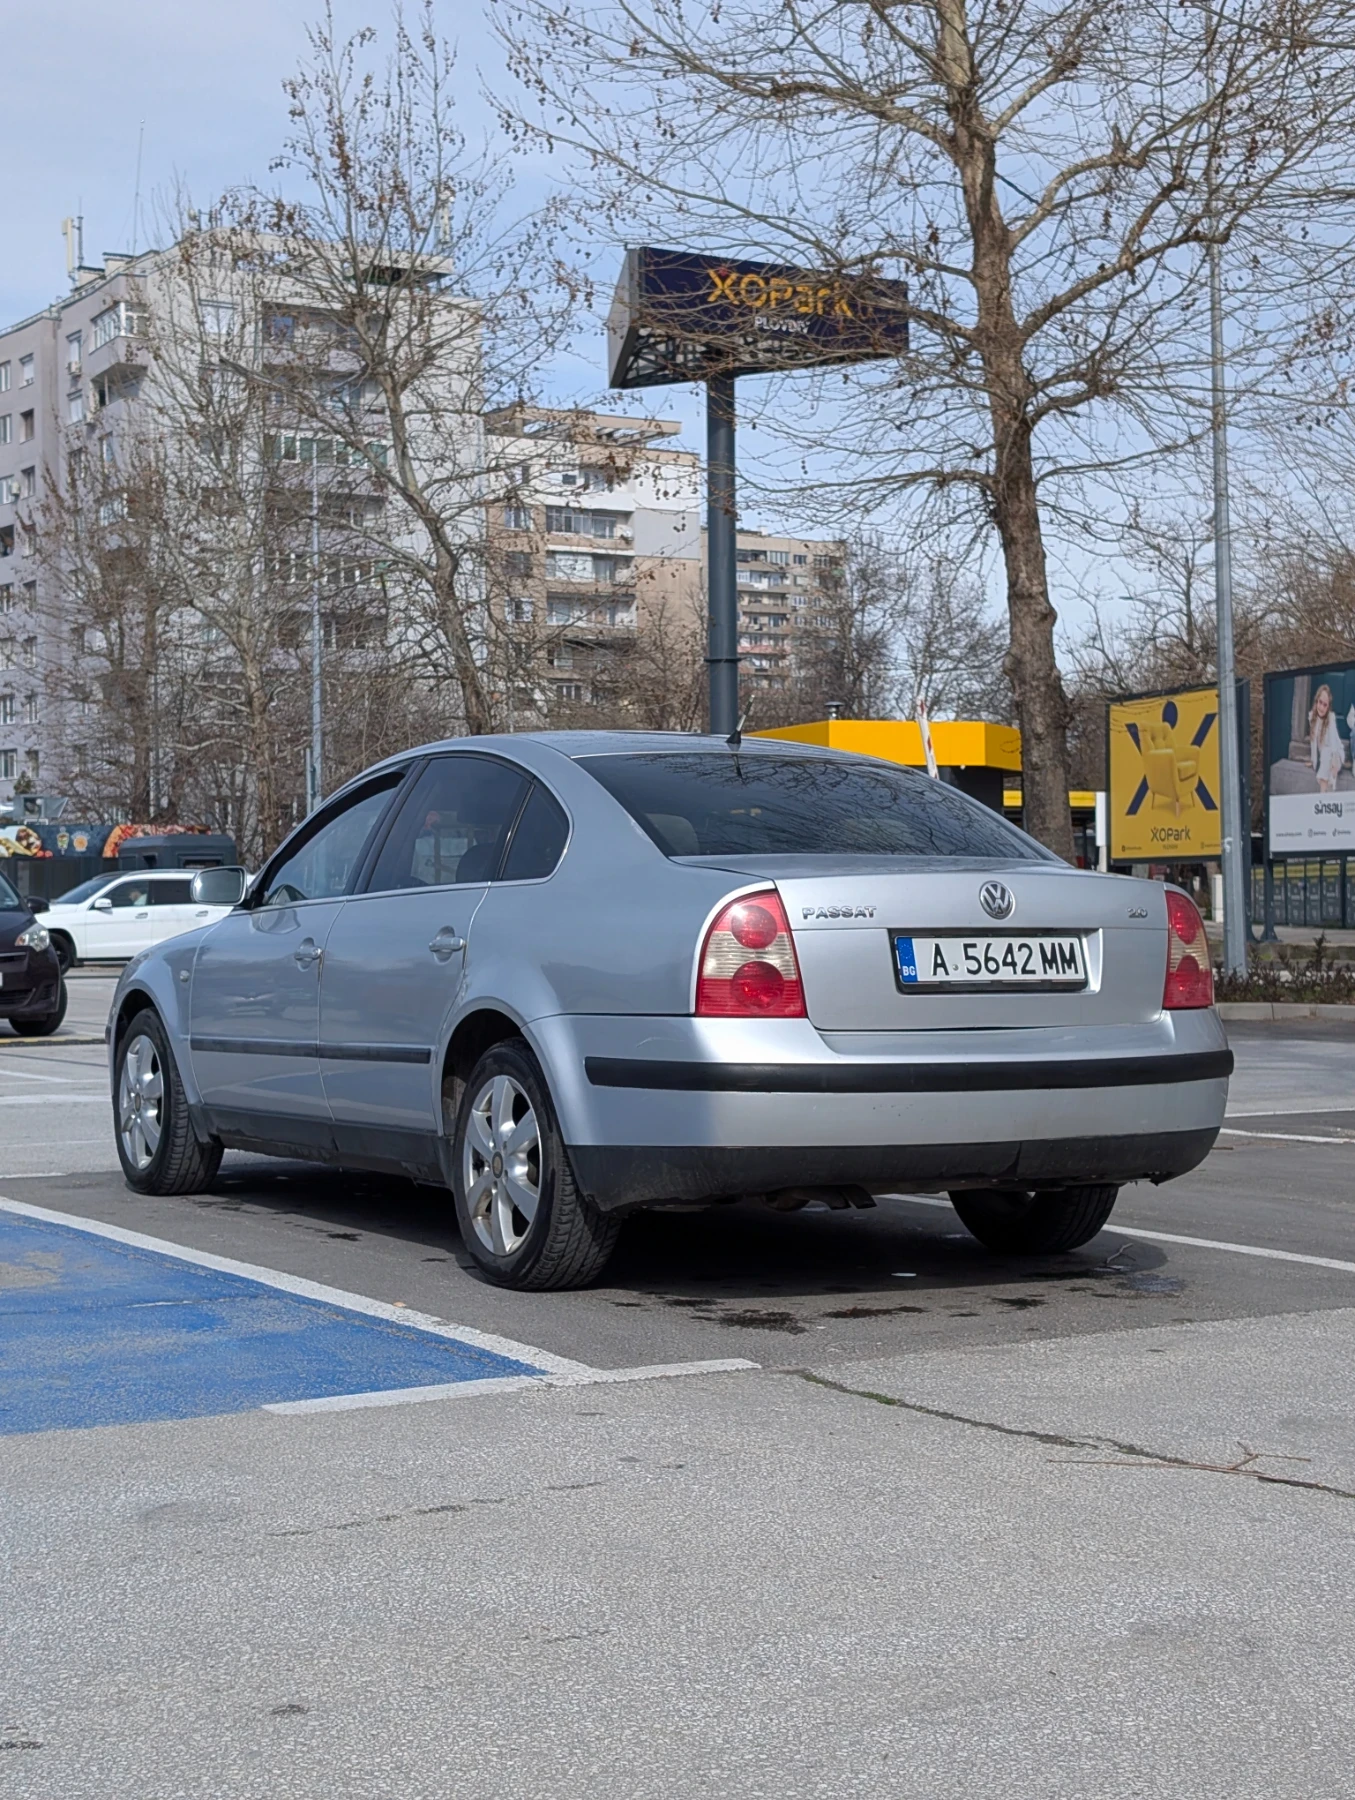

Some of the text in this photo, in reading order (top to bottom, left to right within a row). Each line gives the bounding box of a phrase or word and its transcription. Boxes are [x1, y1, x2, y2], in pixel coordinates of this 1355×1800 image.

[1314, 800, 1342, 818] sinsay
[1150, 826, 1191, 842] XOPark
[802, 906, 877, 919] PASSAT
[902, 965, 916, 976] BG
